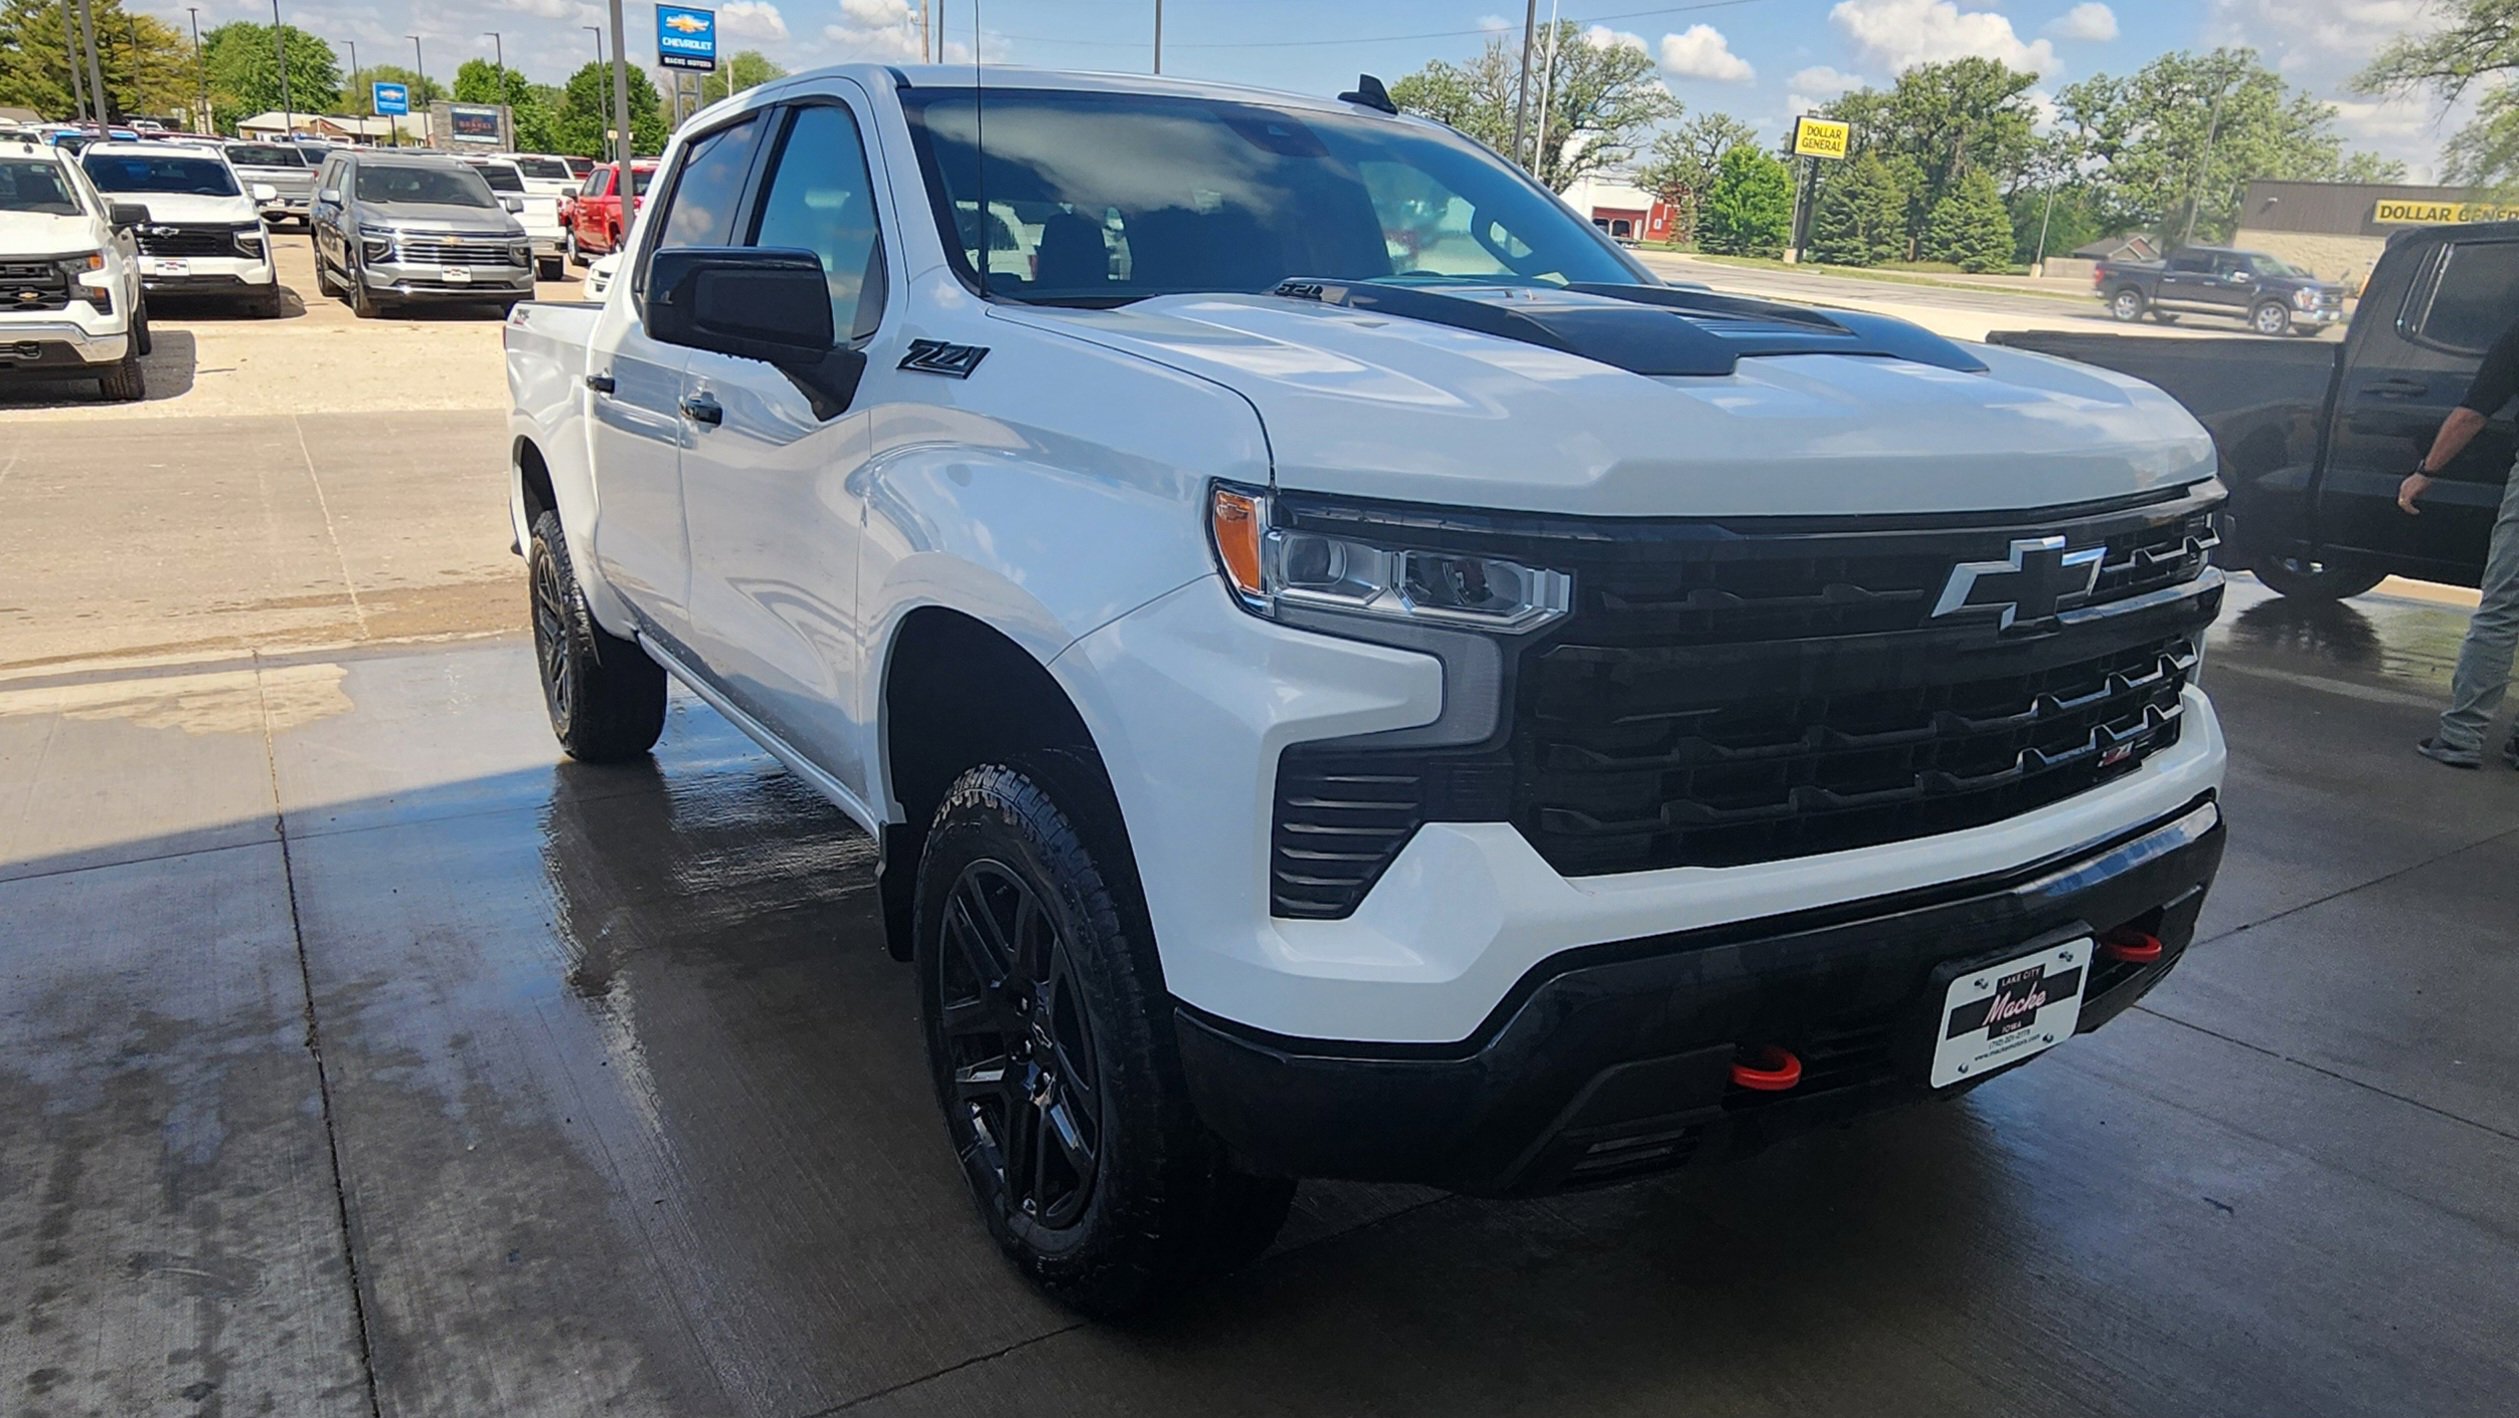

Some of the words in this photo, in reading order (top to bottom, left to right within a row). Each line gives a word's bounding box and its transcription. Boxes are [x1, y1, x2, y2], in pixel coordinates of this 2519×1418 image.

[662, 37, 712, 50] CHEVROLET
[1807, 125, 1841, 139] DOLLAR
[1802, 137, 1842, 152] GENERAL
[2380, 205, 2451, 221] DOLLAR
[896, 338, 991, 380] Z71
[2002, 974, 2021, 986] LAKE
[2023, 968, 2040, 979] CITY
[1982, 980, 2047, 1026] Macke
[2002, 1021, 2021, 1033] IOWA
